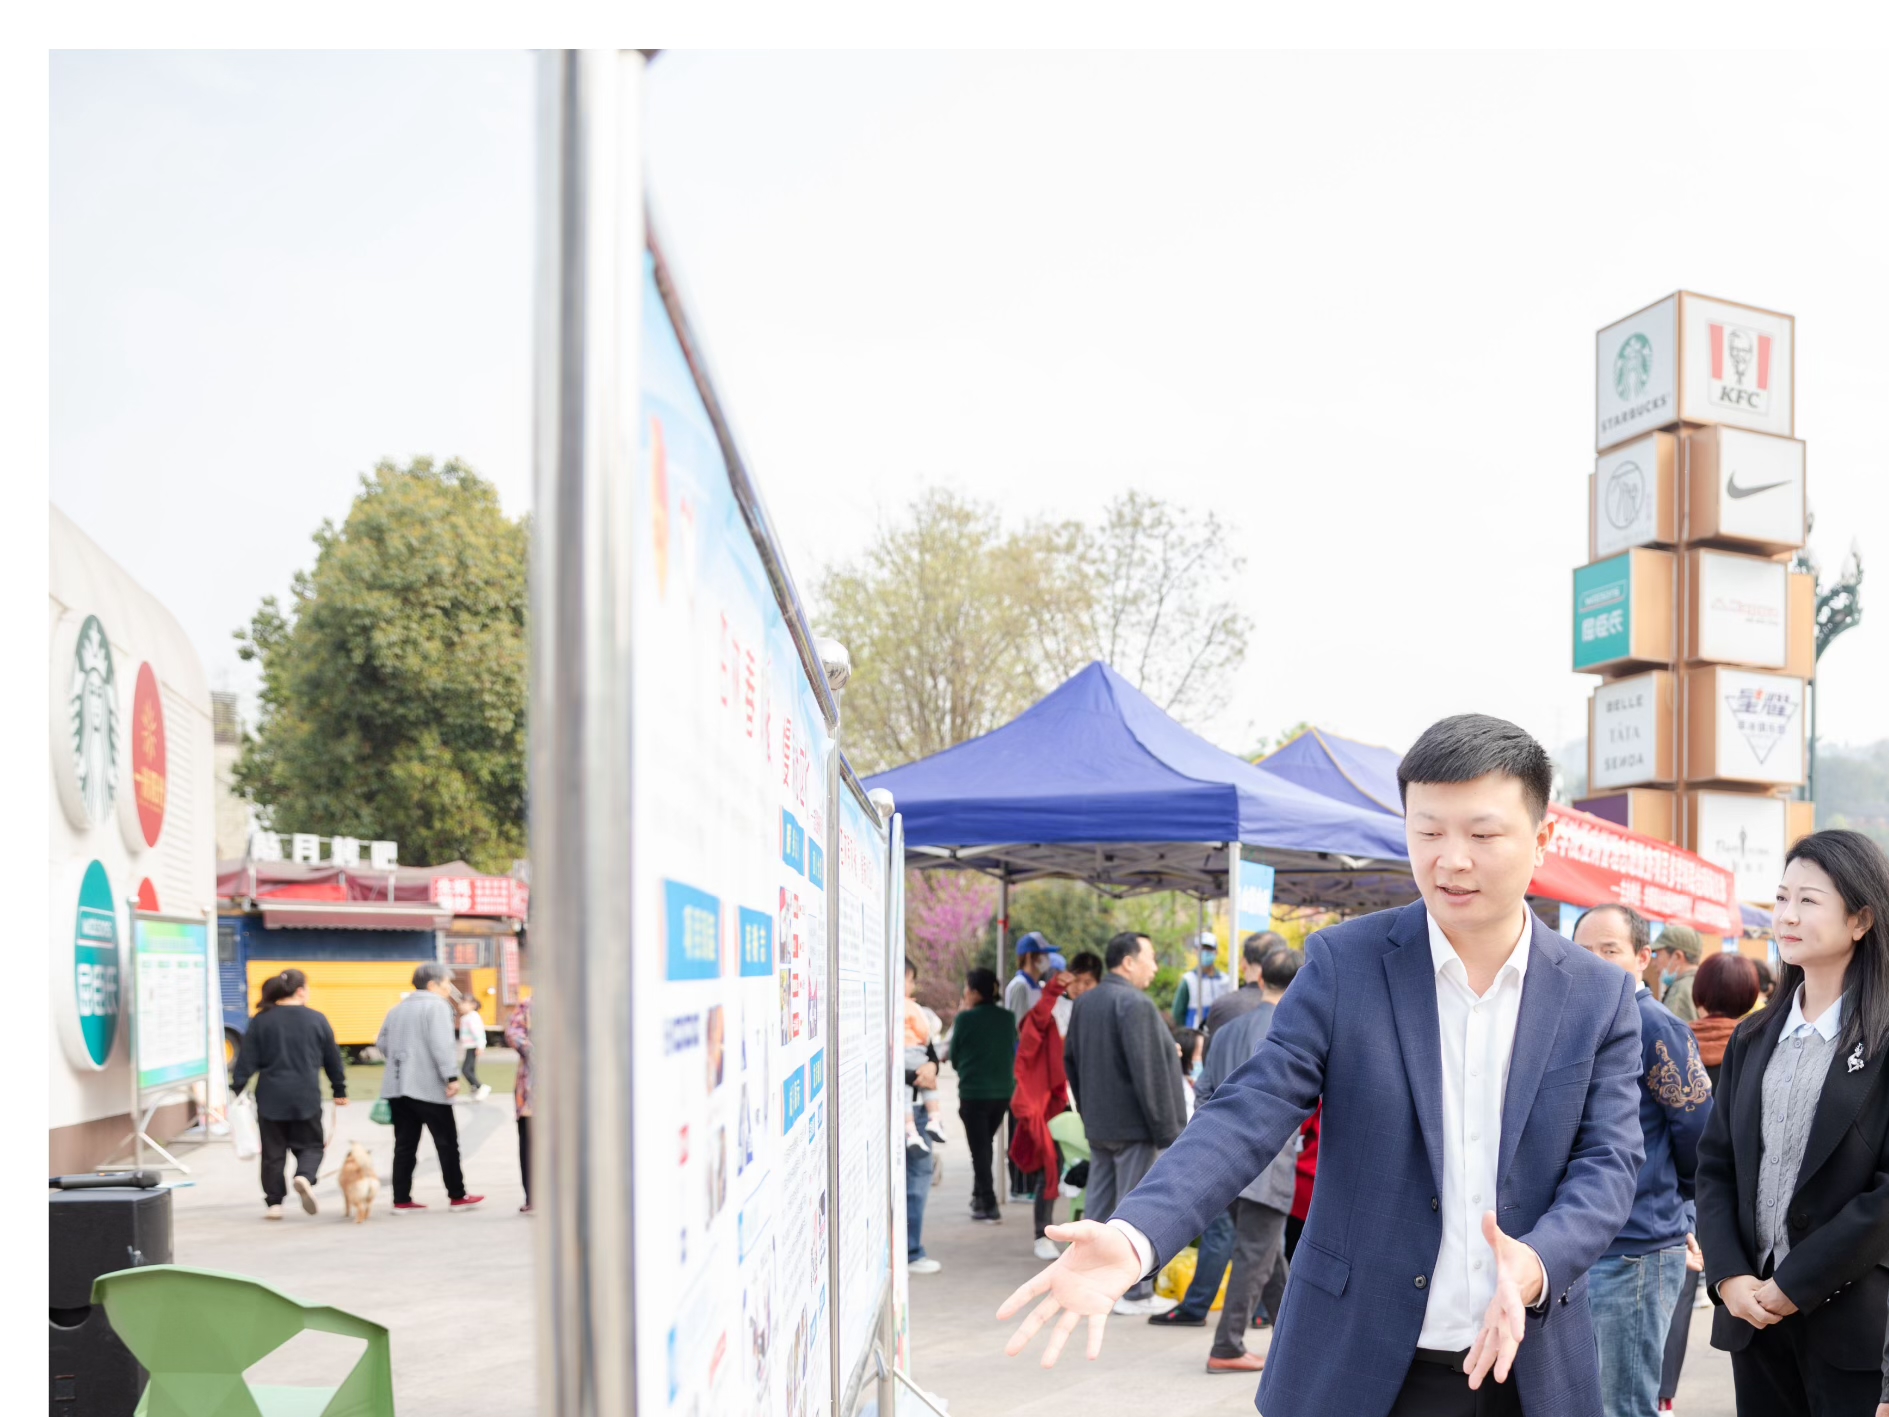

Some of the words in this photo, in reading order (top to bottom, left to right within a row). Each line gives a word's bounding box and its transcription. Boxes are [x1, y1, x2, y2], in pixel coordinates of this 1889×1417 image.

[1719, 385, 1761, 409] KFC
[1600, 395, 1668, 433] STARBUCKS
[1606, 693, 1644, 713] BELLE
